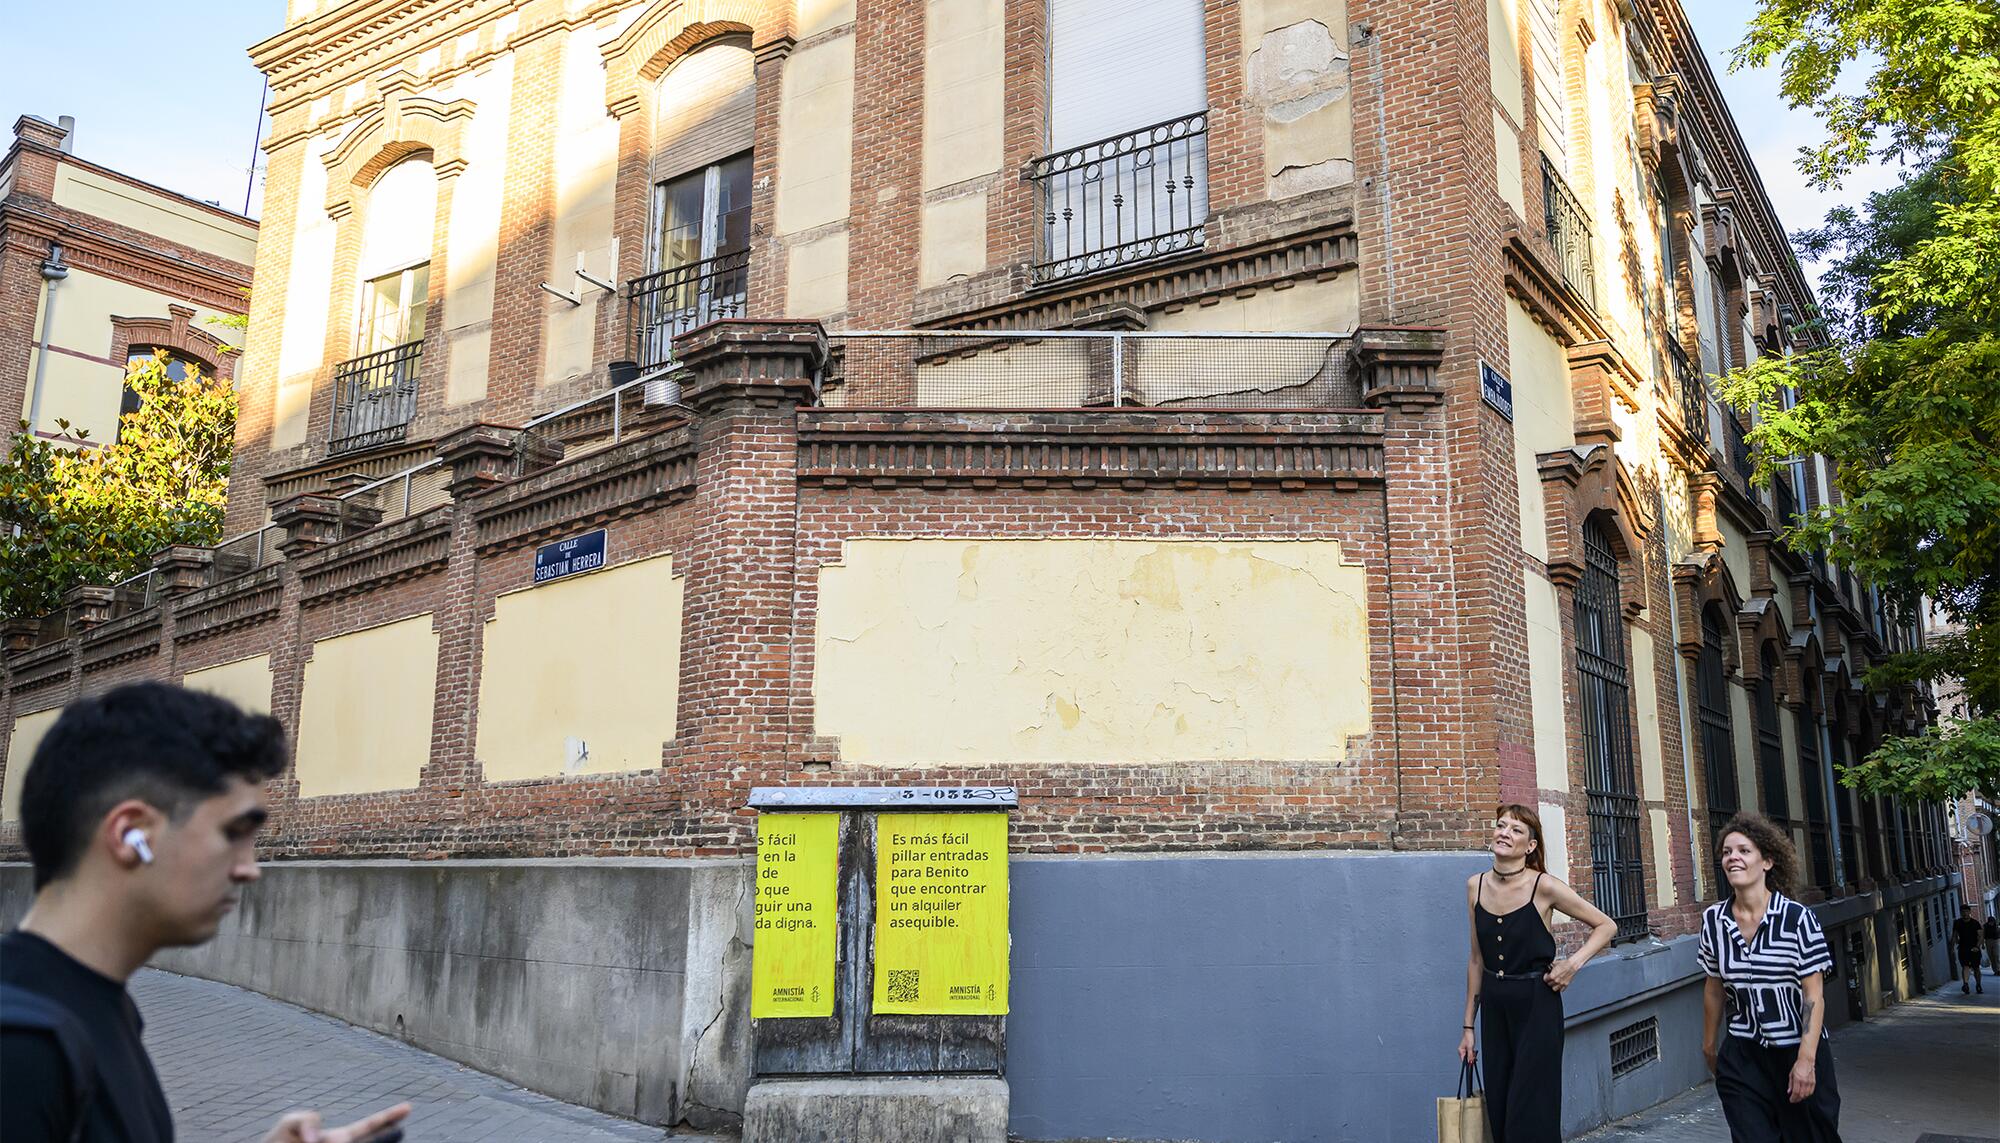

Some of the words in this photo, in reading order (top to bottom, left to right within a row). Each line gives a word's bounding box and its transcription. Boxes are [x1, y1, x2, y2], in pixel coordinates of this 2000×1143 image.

[559, 539, 578, 551] CALLE
[572, 552, 601, 571] HERRERA
[769, 834, 796, 845] fácil
[892, 834, 906, 845] Es
[910, 833, 937, 844] más
[942, 833, 969, 844] fácil
[764, 852, 780, 862] en
[785, 851, 796, 862] la
[892, 850, 926, 864] pillar
[930, 850, 989, 860] entradas
[762, 868, 778, 878] de
[892, 868, 921, 880] para
[926, 867, 969, 877] Benito
[764, 886, 789, 898] que
[891, 885, 916, 897] que
[921, 883, 986, 894] encontrar
[787, 902, 812, 911] una
[891, 902, 907, 911] un
[912, 900, 961, 913] alquiler
[776, 917, 816, 931] digna.
[890, 916, 958, 930] asequible.
[773, 986, 804, 996] AMNISTÍA
[950, 984, 980, 994] AMNISTÍA
